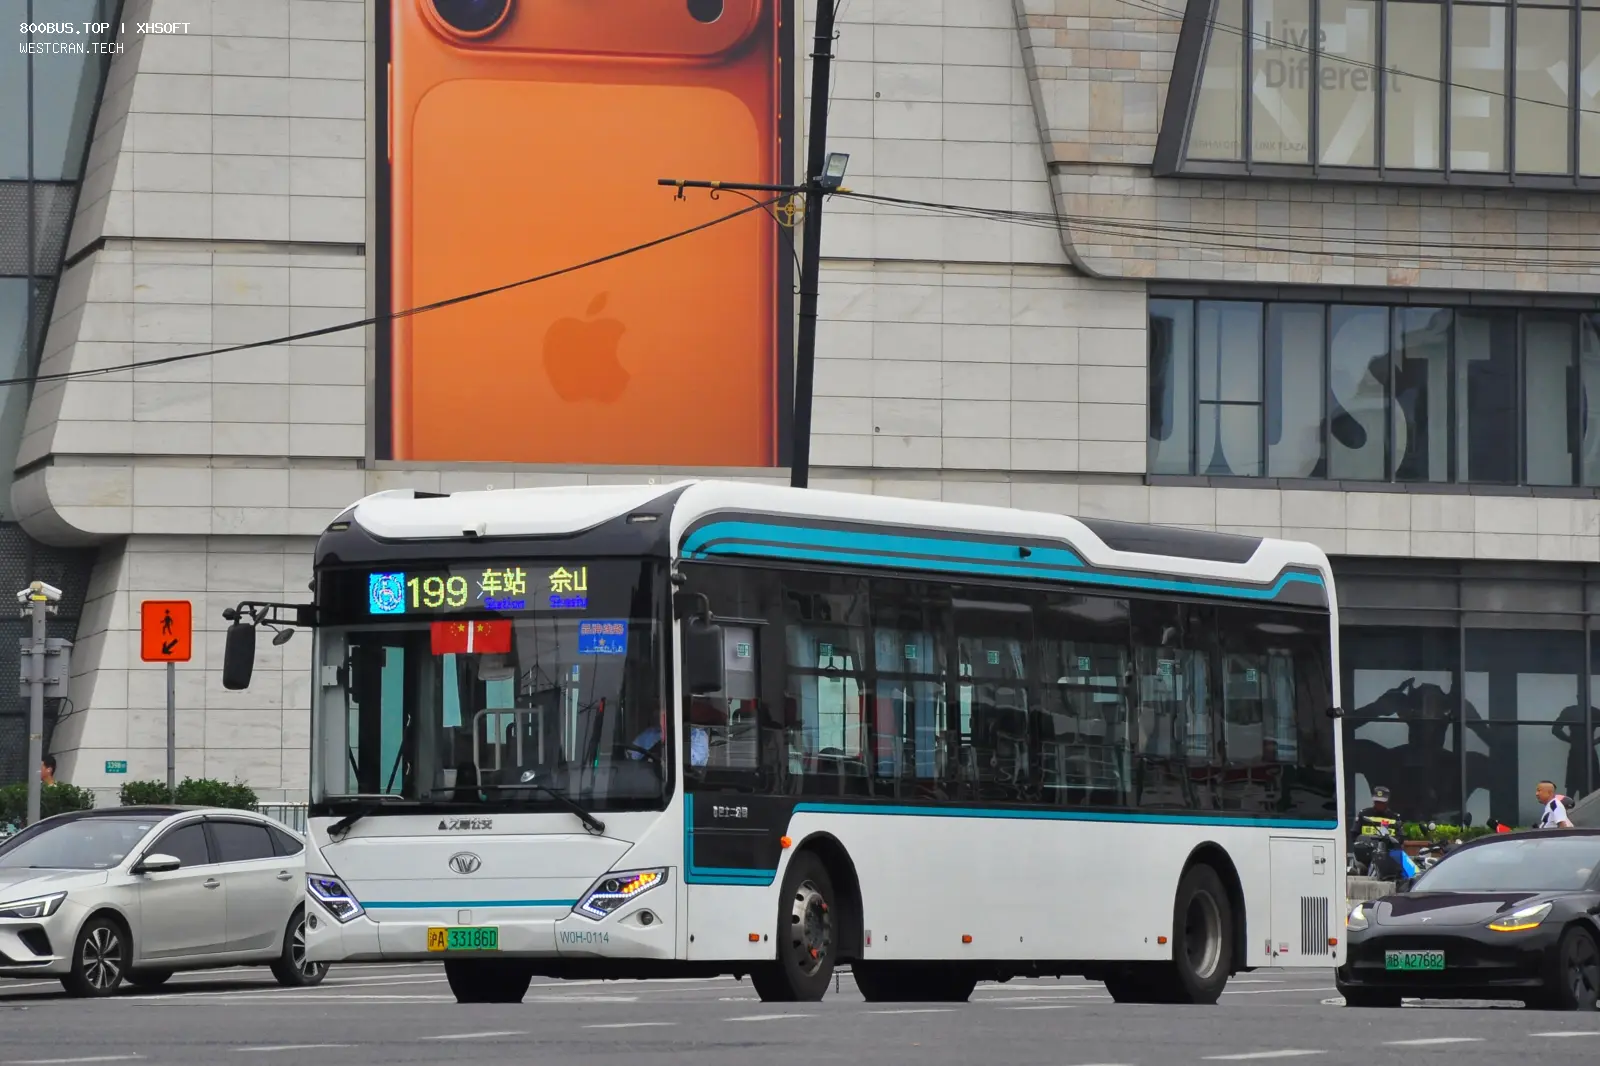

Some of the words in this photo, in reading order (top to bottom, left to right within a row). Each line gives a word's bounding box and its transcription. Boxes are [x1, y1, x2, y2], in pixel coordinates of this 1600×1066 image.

[1265, 19, 1327, 51] Live
[1265, 58, 1402, 93] Diferet
[407, 576, 468, 608] 199
[482, 568, 527, 596] 车站
[449, 818, 493, 831] 久公交
[451, 930, 496, 947] 33186D
[1386, 954, 1399, 967] B
[1405, 954, 1443, 968] A27682
